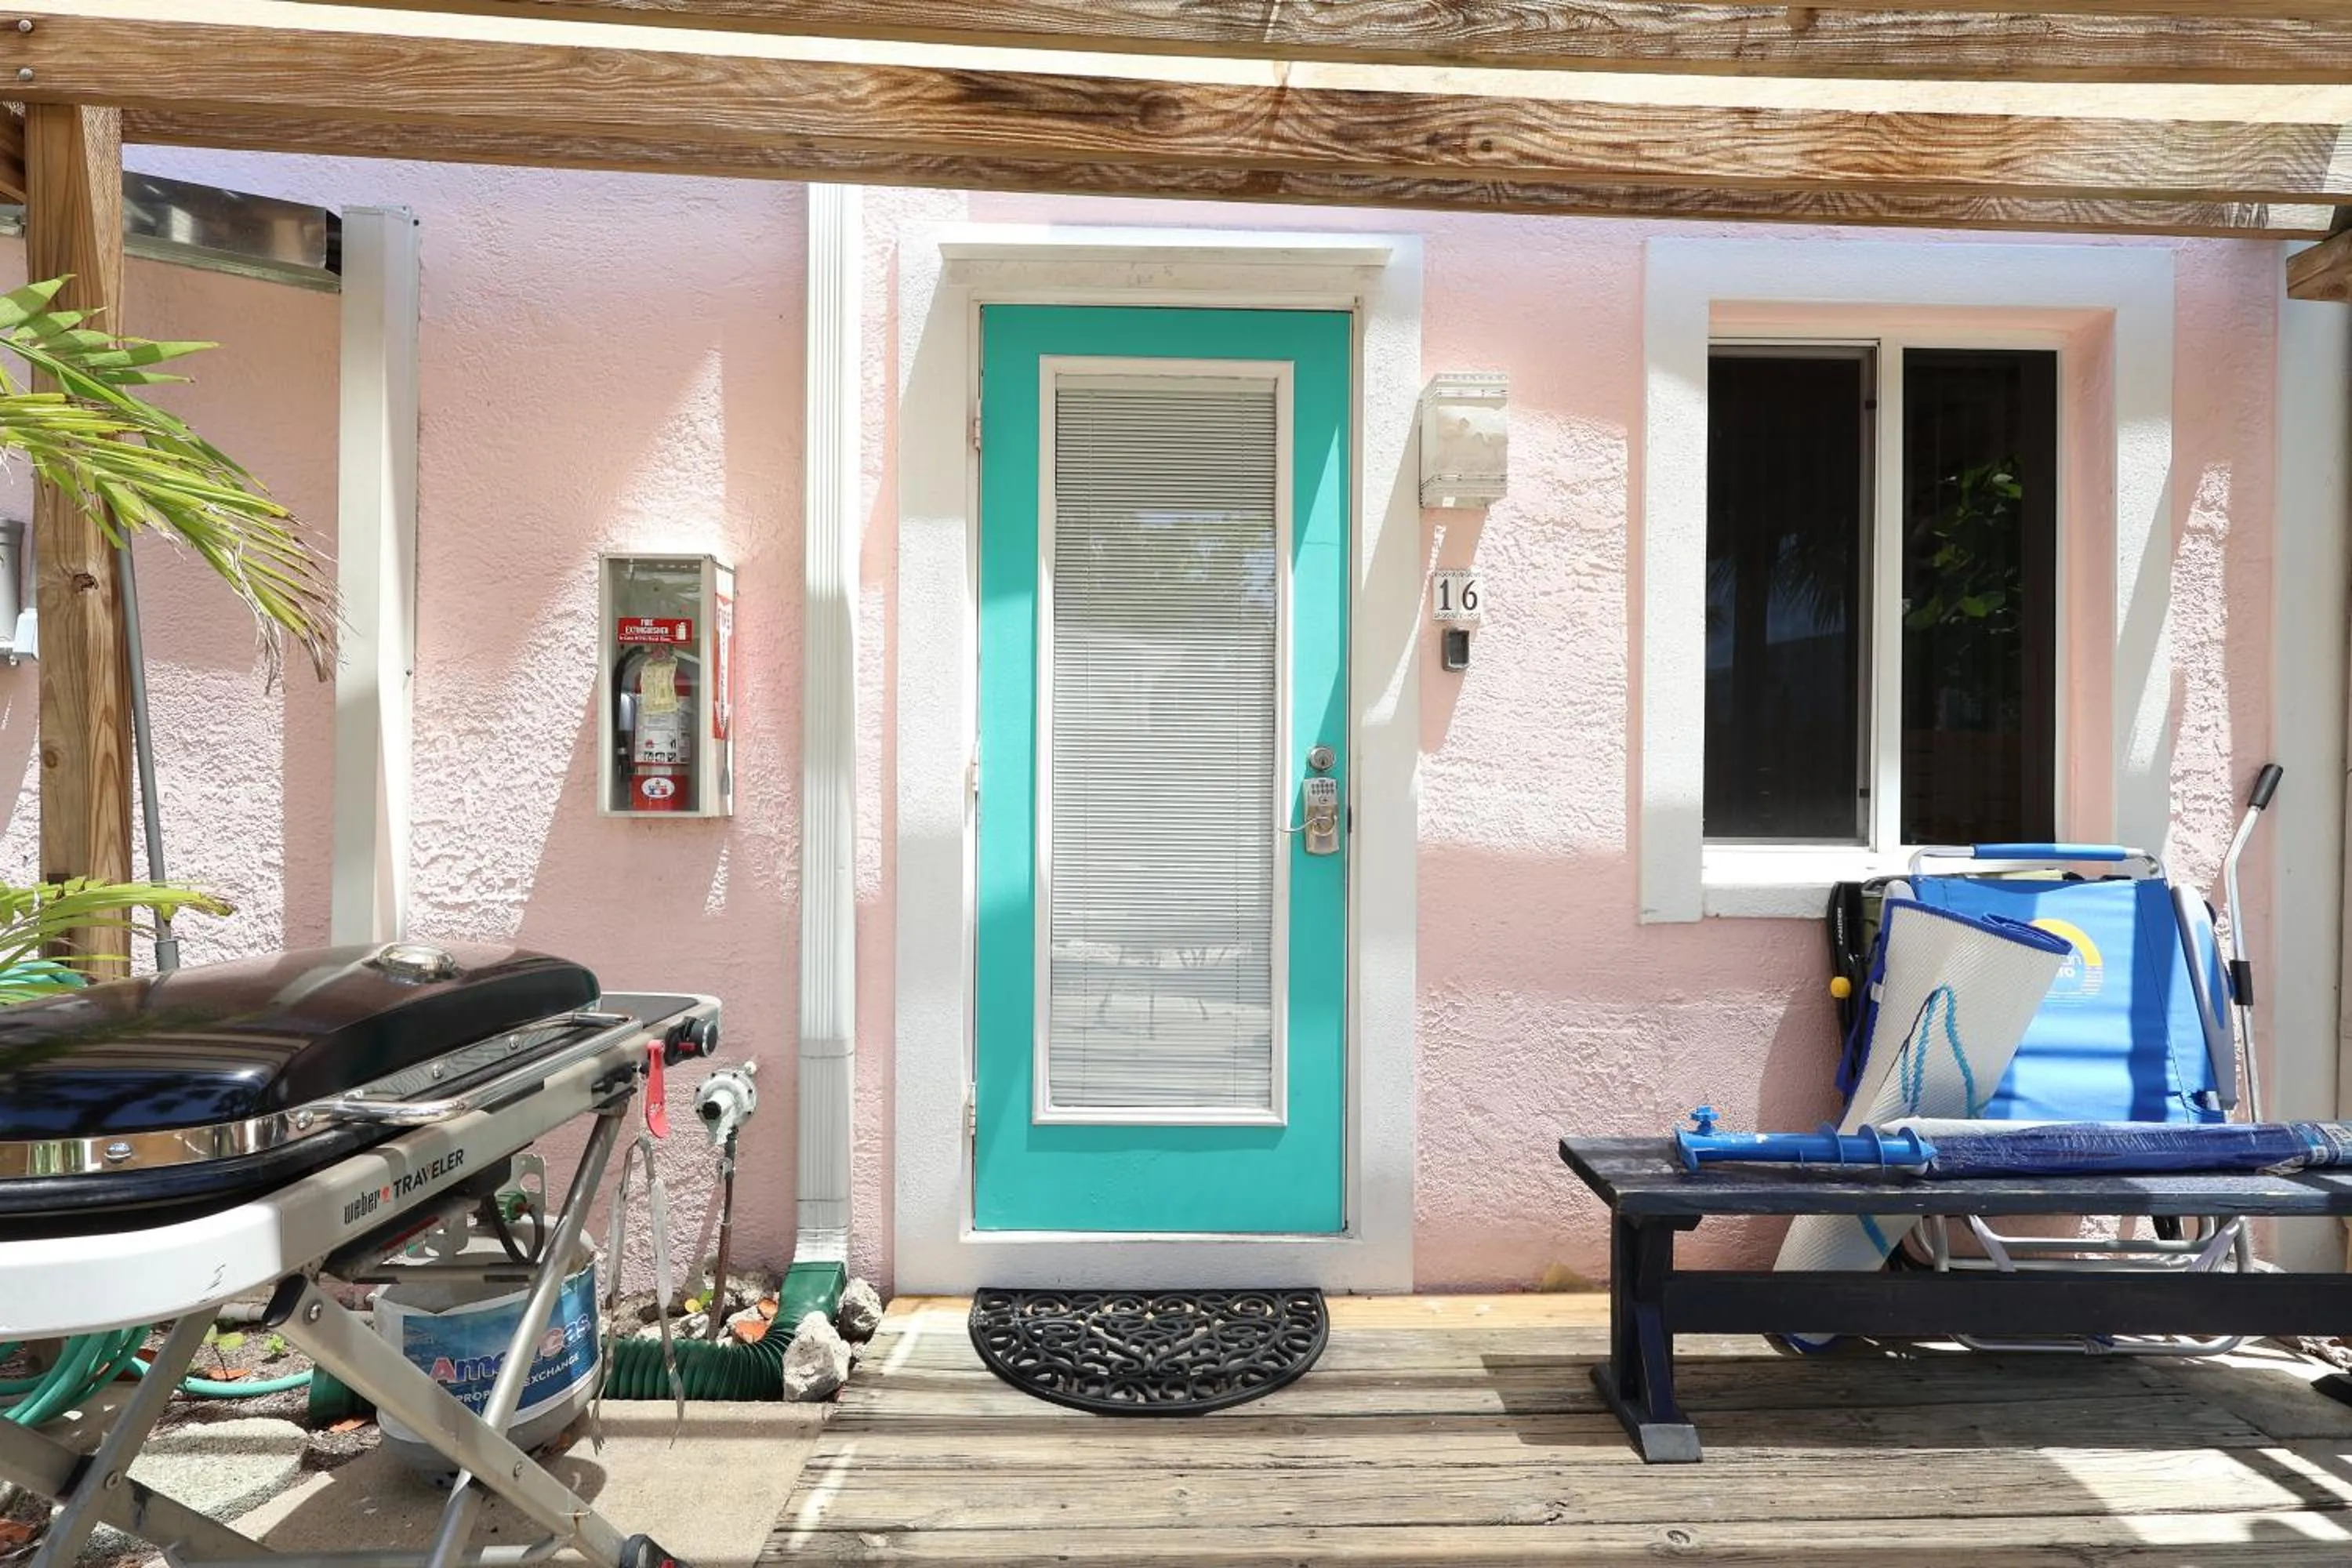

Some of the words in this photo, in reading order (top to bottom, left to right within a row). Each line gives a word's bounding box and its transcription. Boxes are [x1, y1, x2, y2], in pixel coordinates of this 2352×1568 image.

[1439, 579, 1478, 611] 16
[344, 1189, 380, 1225] weber
[393, 1149, 464, 1199] TRAVELER
